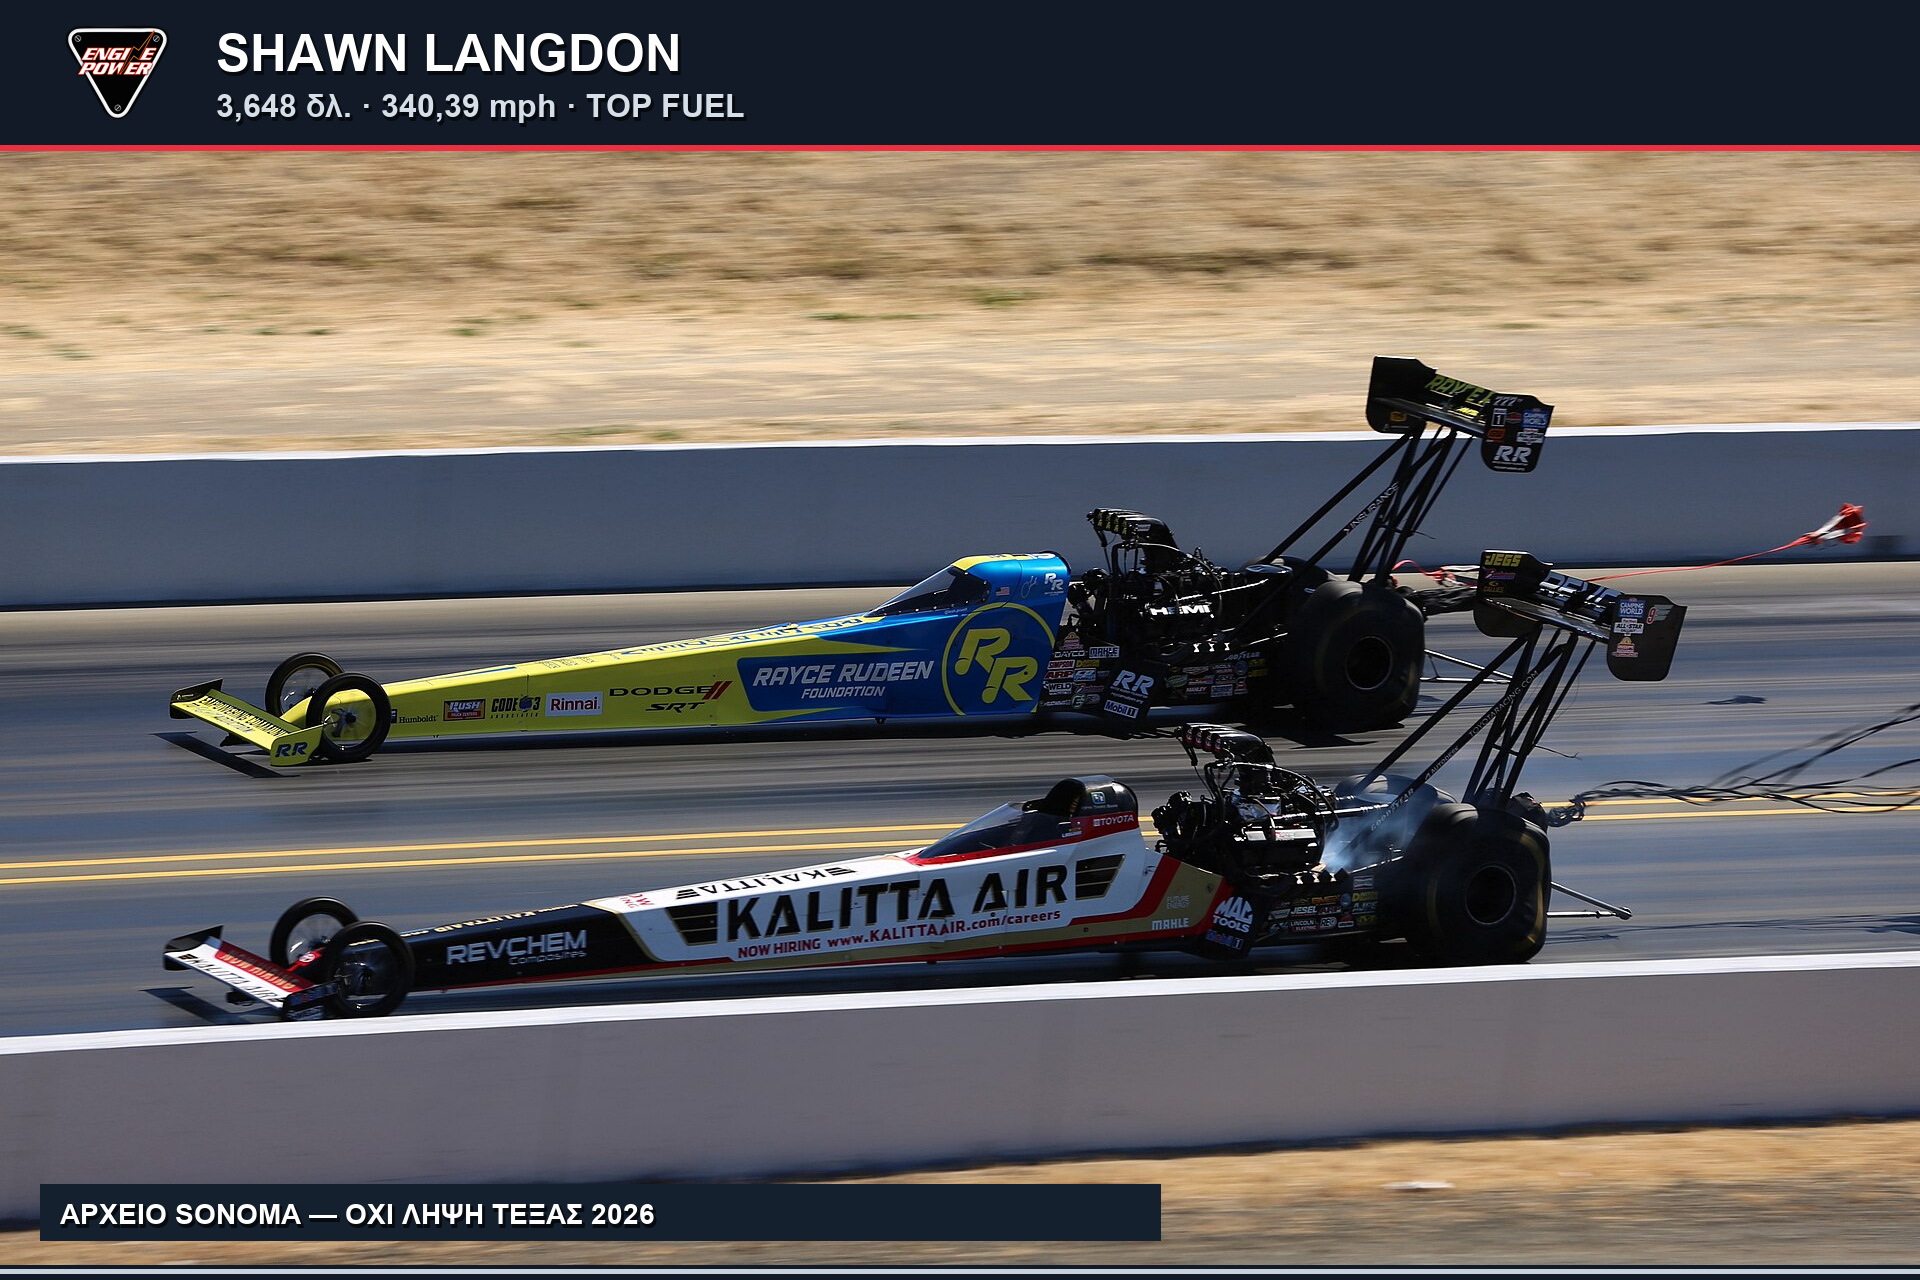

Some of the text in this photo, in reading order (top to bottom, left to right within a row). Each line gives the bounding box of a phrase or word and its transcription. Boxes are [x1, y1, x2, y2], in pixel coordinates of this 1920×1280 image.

[1493, 446, 1532, 463] RR
[1484, 553, 1522, 567] JEGS
[1044, 573, 1064, 590] RR
[1646, 606, 1657, 624] 9
[1054, 650, 1086, 658] DAYCO
[752, 660, 935, 687] RAYCE RUDEEN
[954, 627, 1039, 704] RR
[609, 685, 716, 696] DODGE
[1112, 669, 1155, 696] RR
[801, 686, 886, 700] FOUNDATION
[449, 701, 480, 713] RUSH
[491, 696, 541, 712] CODE 3
[551, 697, 599, 711] Rinnai
[644, 702, 707, 714] SRT
[1105, 701, 1128, 715] Mobil
[399, 715, 438, 724] Humboldt
[274, 741, 308, 758] RR
[1100, 814, 1135, 827] TOYOTA
[699, 869, 829, 895] KALITTA
[727, 863, 1069, 943] KALITTA AIR
[1214, 896, 1255, 925] MAC
[1291, 905, 1318, 914] JESEL
[1151, 917, 1190, 931] MAHLE
[1212, 914, 1251, 934] TOOLS
[446, 929, 588, 965] REVCHEM
[738, 943, 770, 959] NOW
[775, 937, 822, 956] HIRING
[509, 949, 587, 966] Composites
